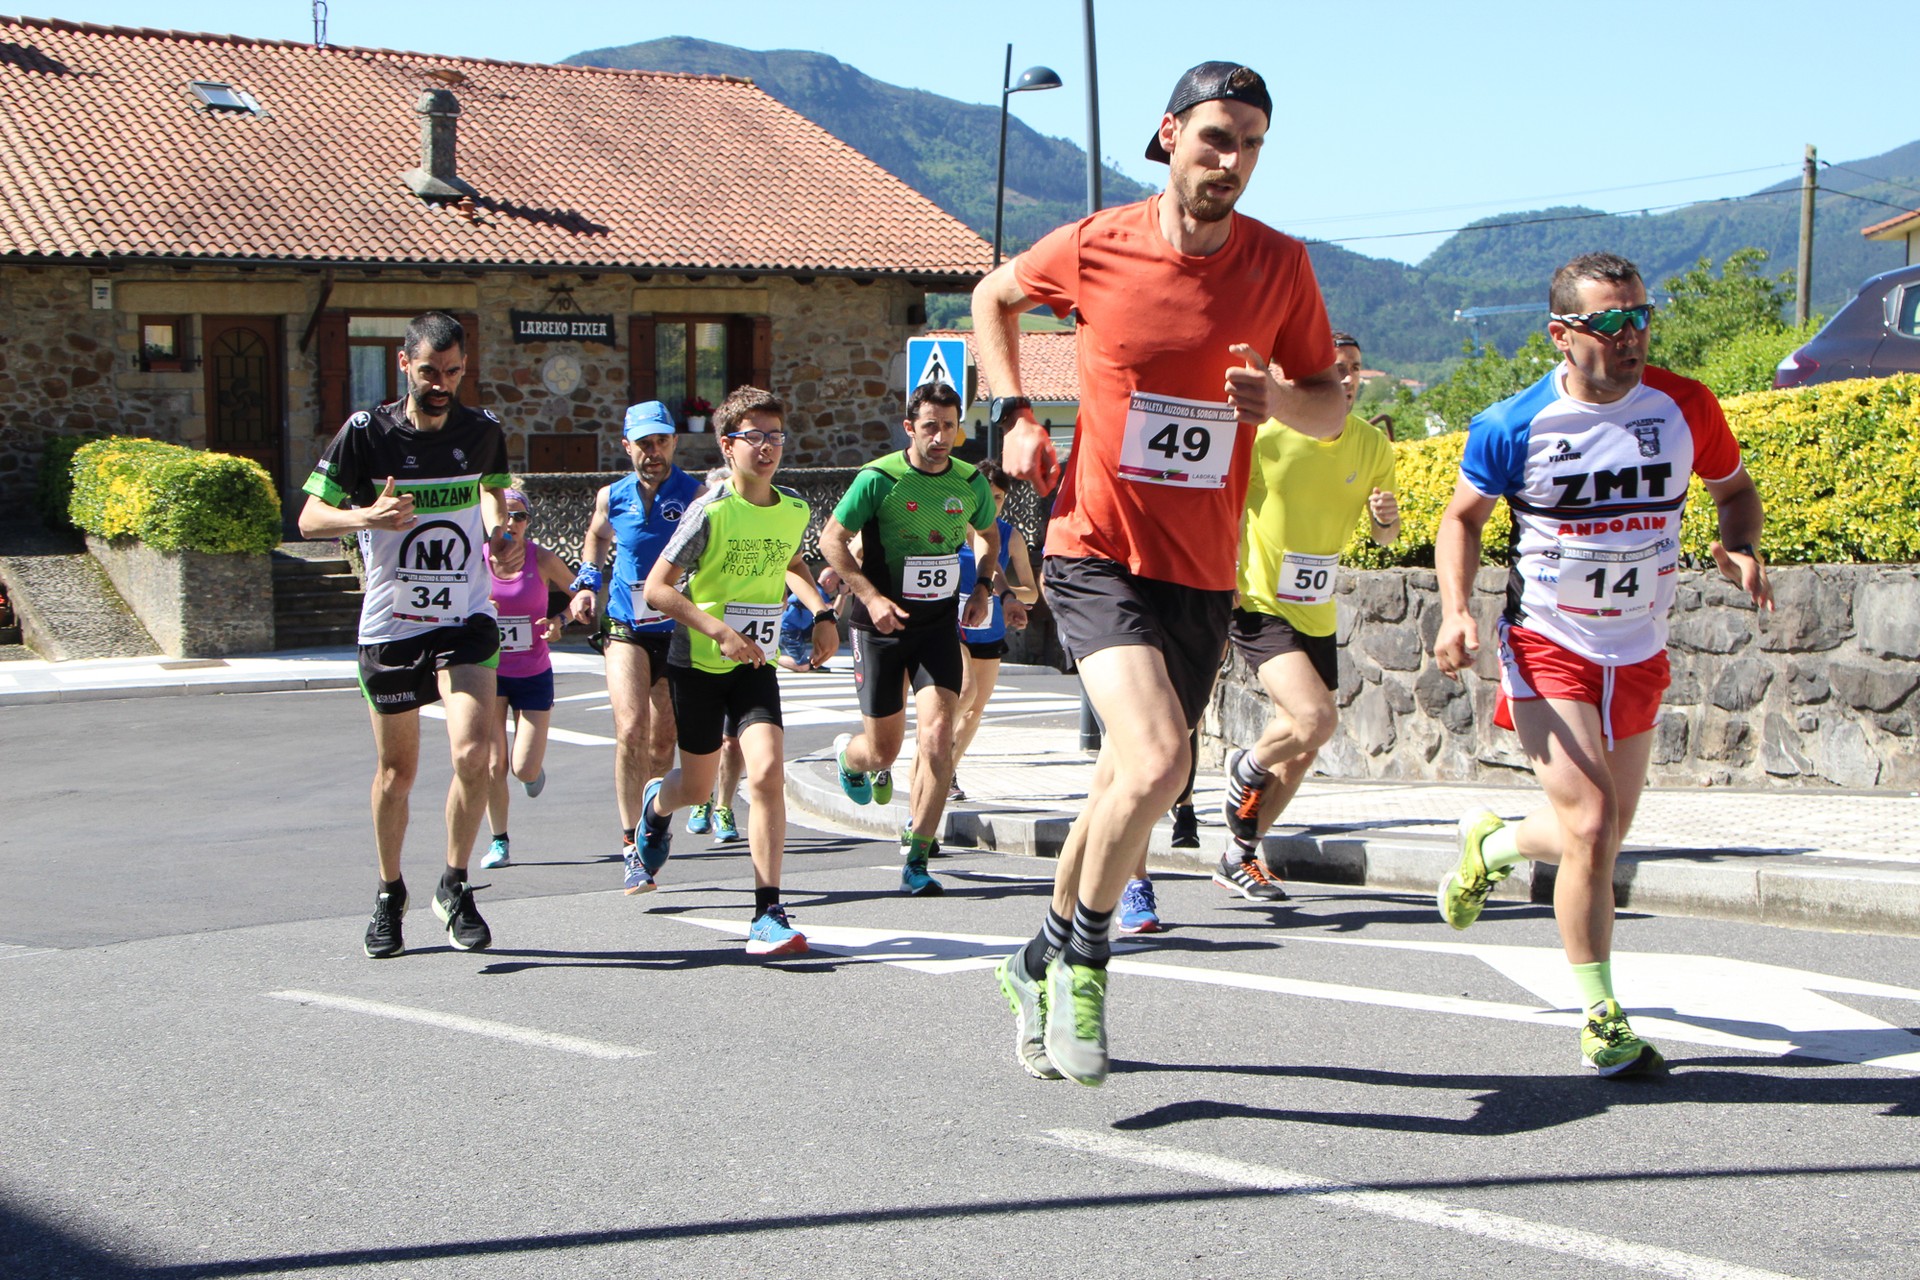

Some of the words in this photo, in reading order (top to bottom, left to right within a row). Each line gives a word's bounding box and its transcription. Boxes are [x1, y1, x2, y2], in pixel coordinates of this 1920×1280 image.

[558, 299, 571, 312] 10
[520, 321, 568, 335] LARREKO
[571, 322, 607, 336] ETXEA
[1132, 399, 1163, 413] ZABALETA
[1164, 404, 1189, 417] AUZOKO
[1196, 409, 1219, 420] SORGIN
[1148, 423, 1211, 462] 49
[1549, 452, 1582, 463] VIATOR
[1552, 462, 1672, 507] ZMT
[1557, 516, 1667, 537] ANDOAIN
[720, 562, 758, 577] KROSA
[917, 569, 948, 588] 58
[1294, 568, 1329, 590] 50
[1585, 567, 1640, 598] 14
[411, 586, 452, 610] 34
[741, 620, 775, 645] 45
